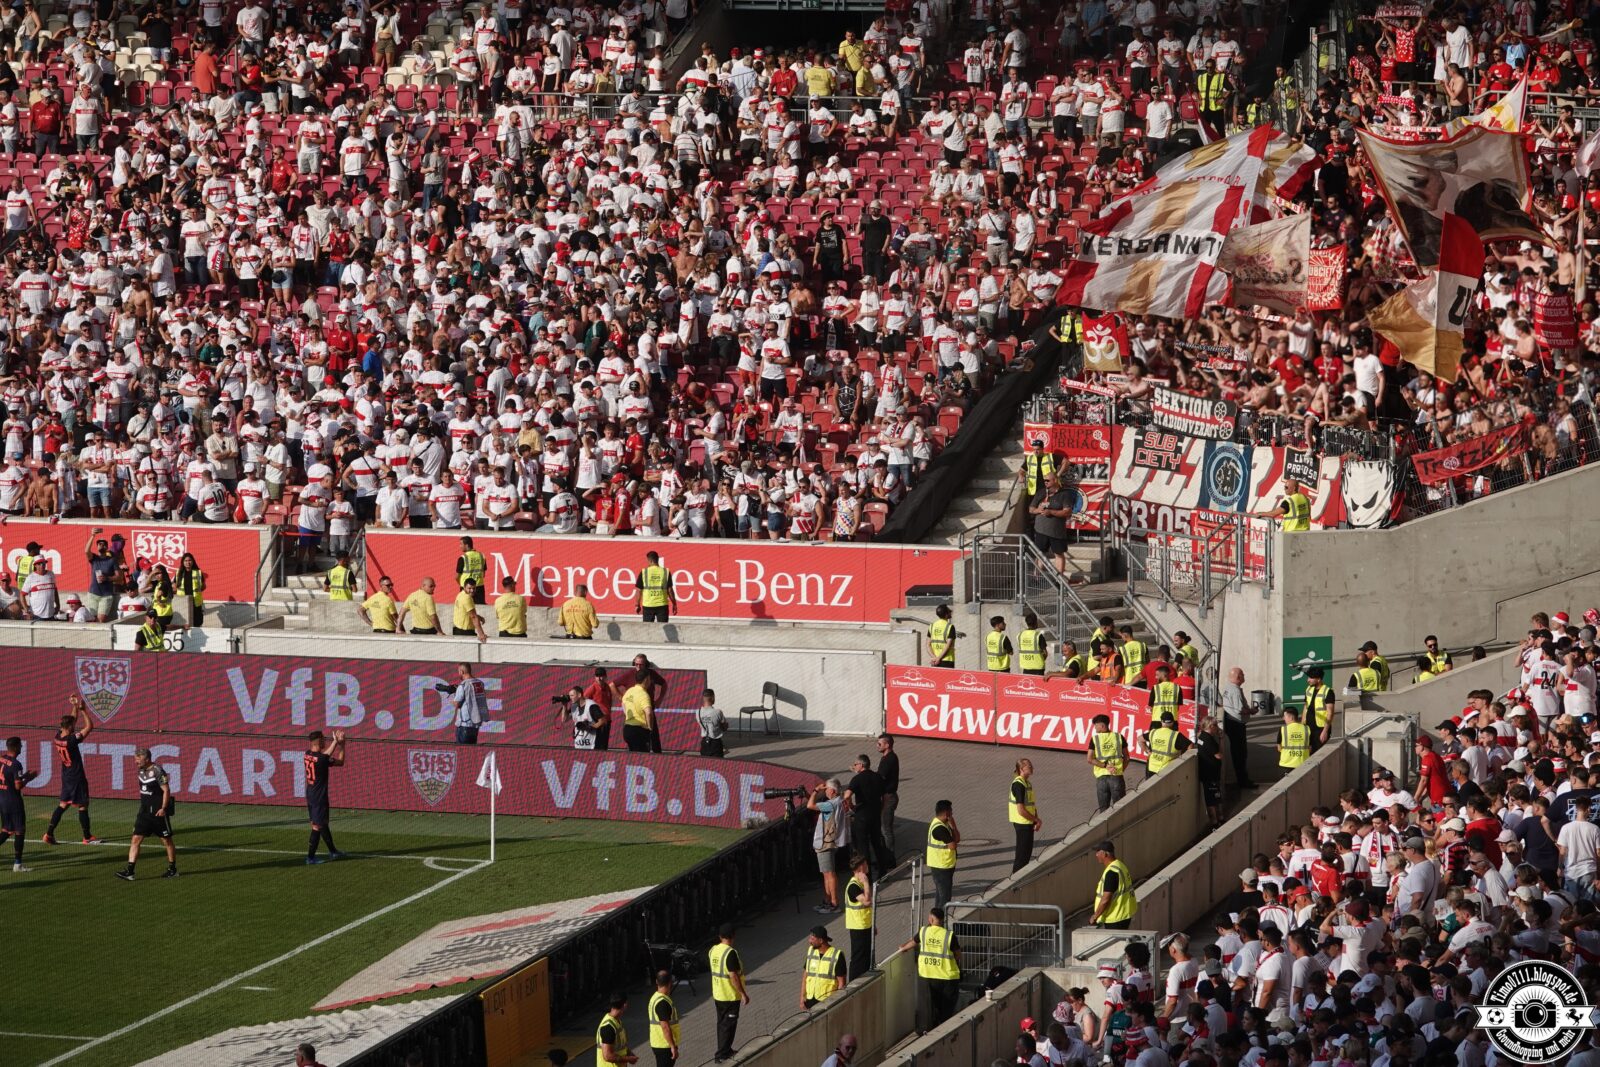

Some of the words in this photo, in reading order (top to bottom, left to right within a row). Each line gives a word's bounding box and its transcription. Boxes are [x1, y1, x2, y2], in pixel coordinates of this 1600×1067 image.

[1154, 387, 1213, 419] SEKTION
[1144, 432, 1178, 451] SUB
[1135, 448, 1182, 470] CIETY
[490, 552, 854, 608] Mercees-Benz
[1540, 671, 1557, 690] 24
[226, 666, 506, 734] VfB.DE
[0, 739, 307, 798] UTGART
[541, 758, 766, 822] VfB.DE
[924, 957, 941, 967] 0395
